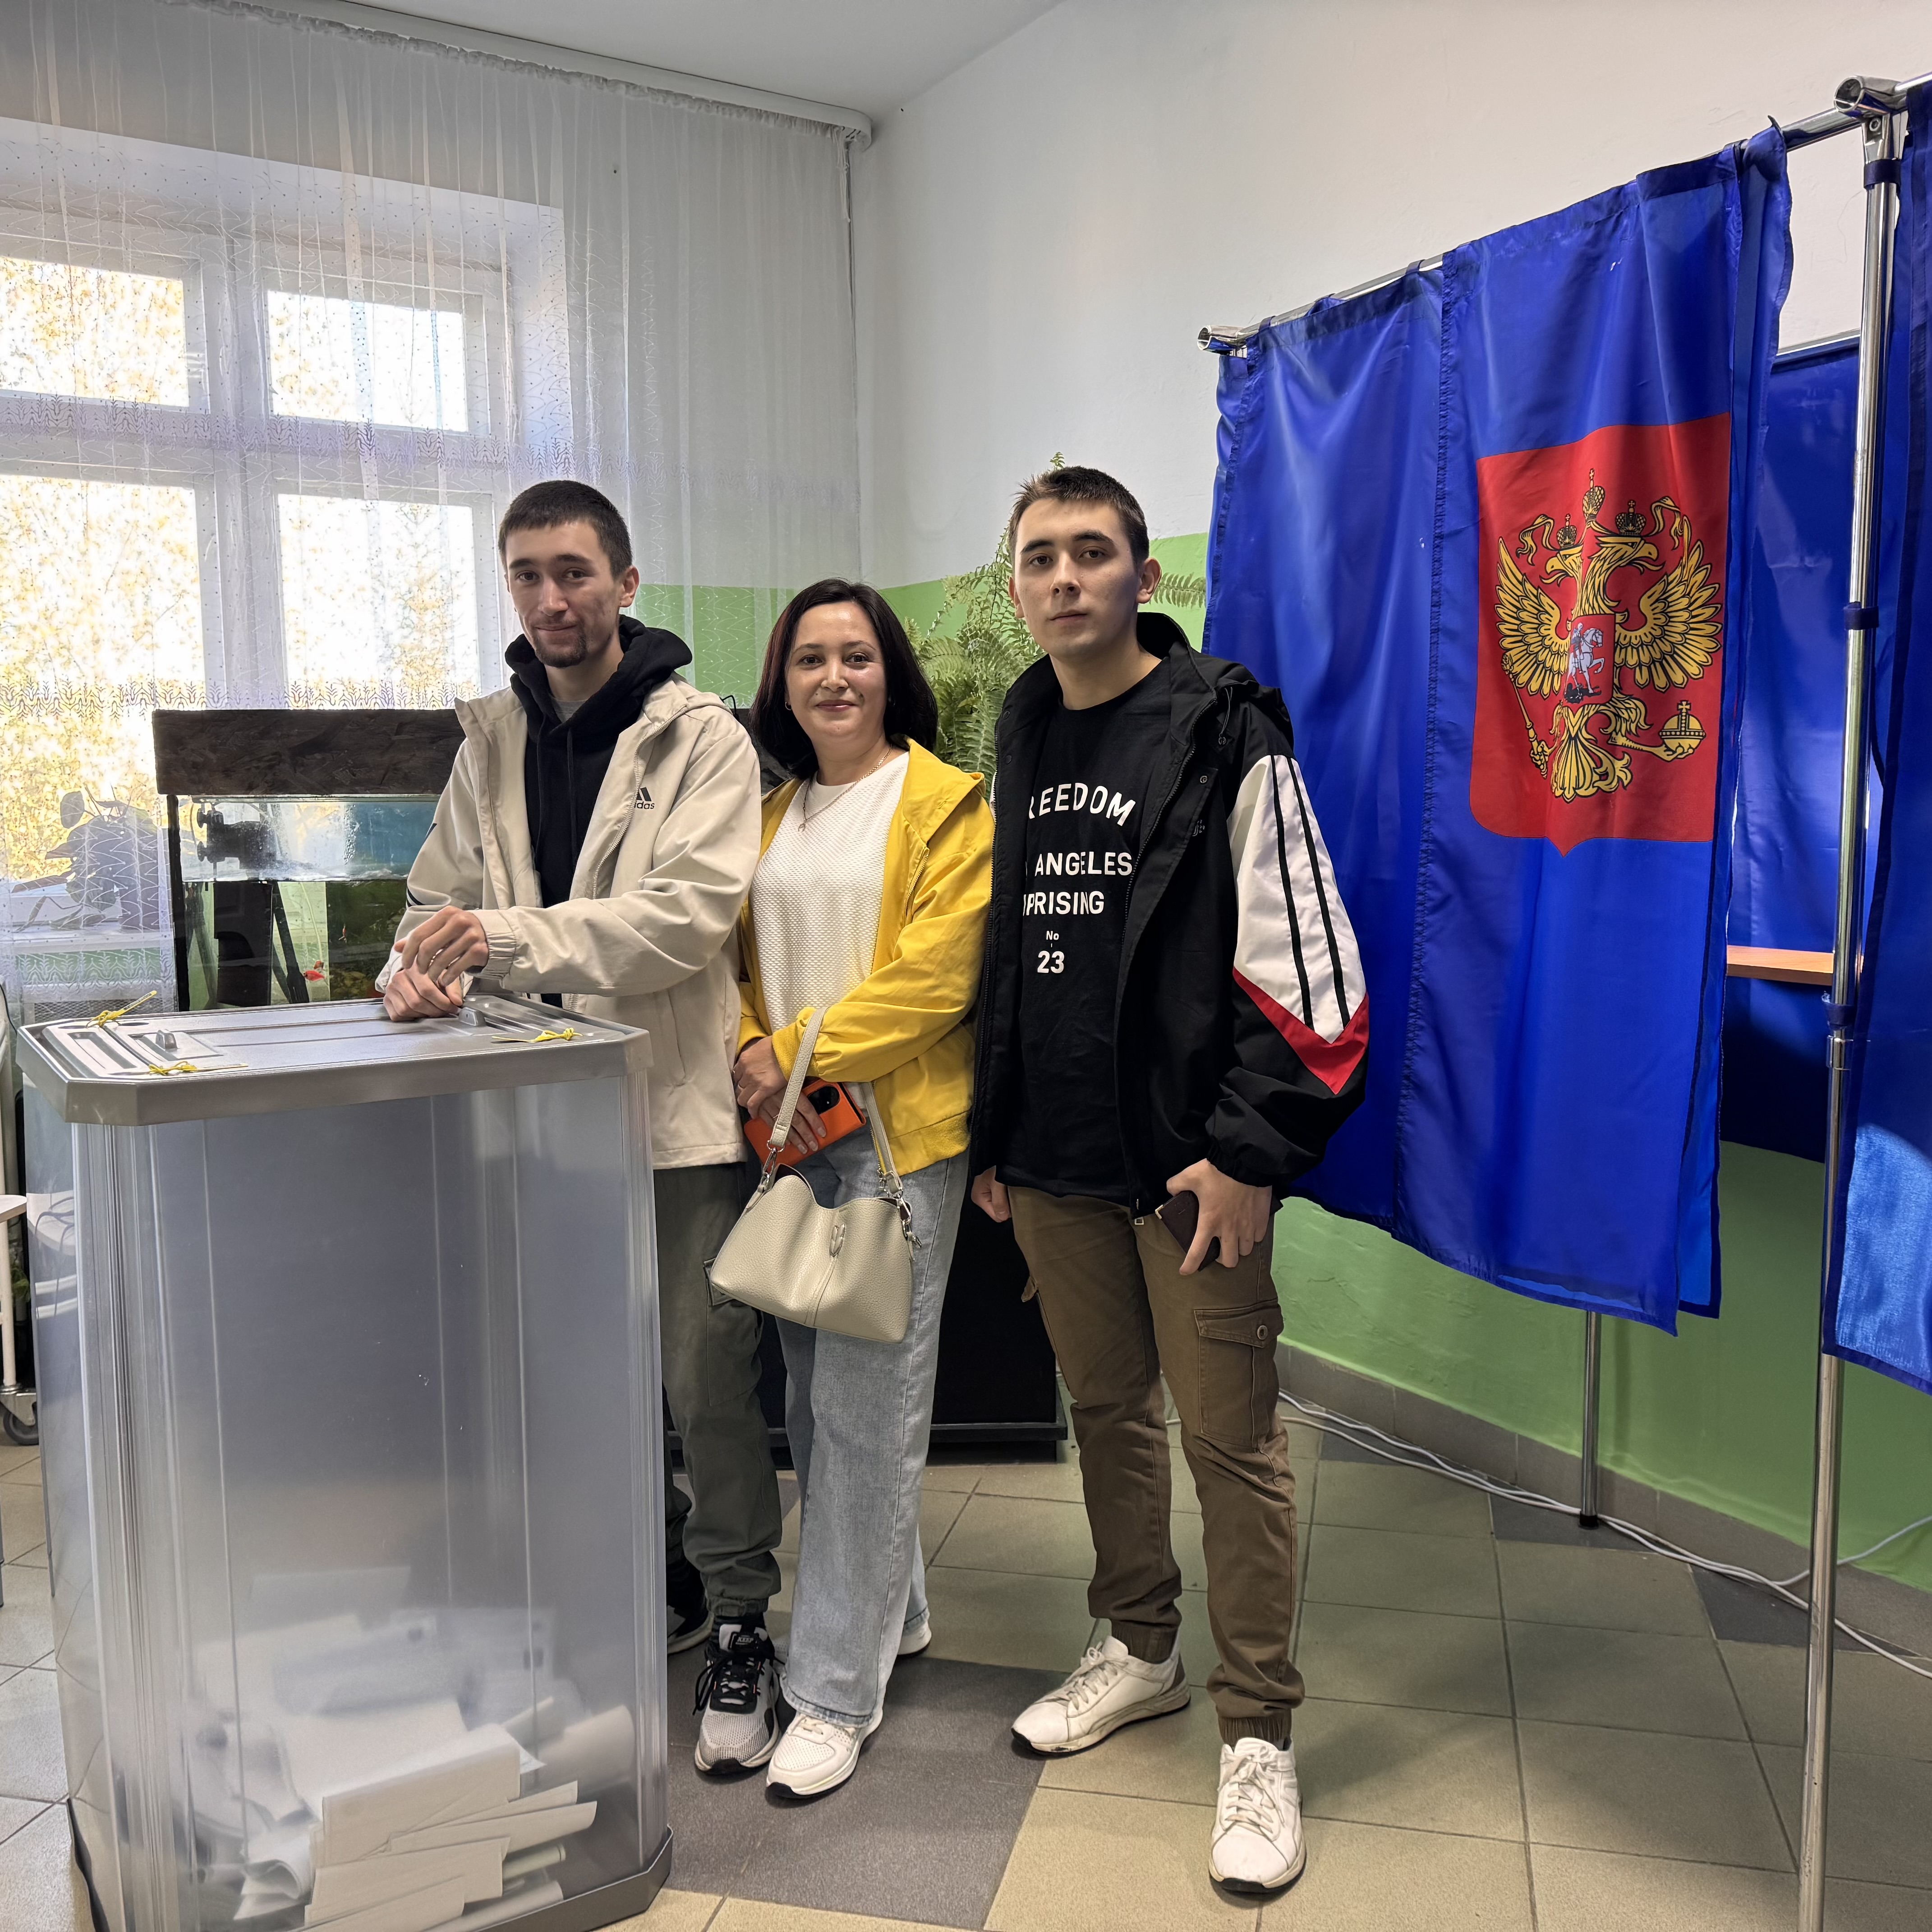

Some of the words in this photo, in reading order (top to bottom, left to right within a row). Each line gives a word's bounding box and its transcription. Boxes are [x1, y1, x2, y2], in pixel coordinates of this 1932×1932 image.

[1035, 851, 1132, 875] ANGELES
[1023, 891, 1104, 916] PRISING
[1046, 930, 1059, 940] No
[1037, 950, 1065, 974] 23
